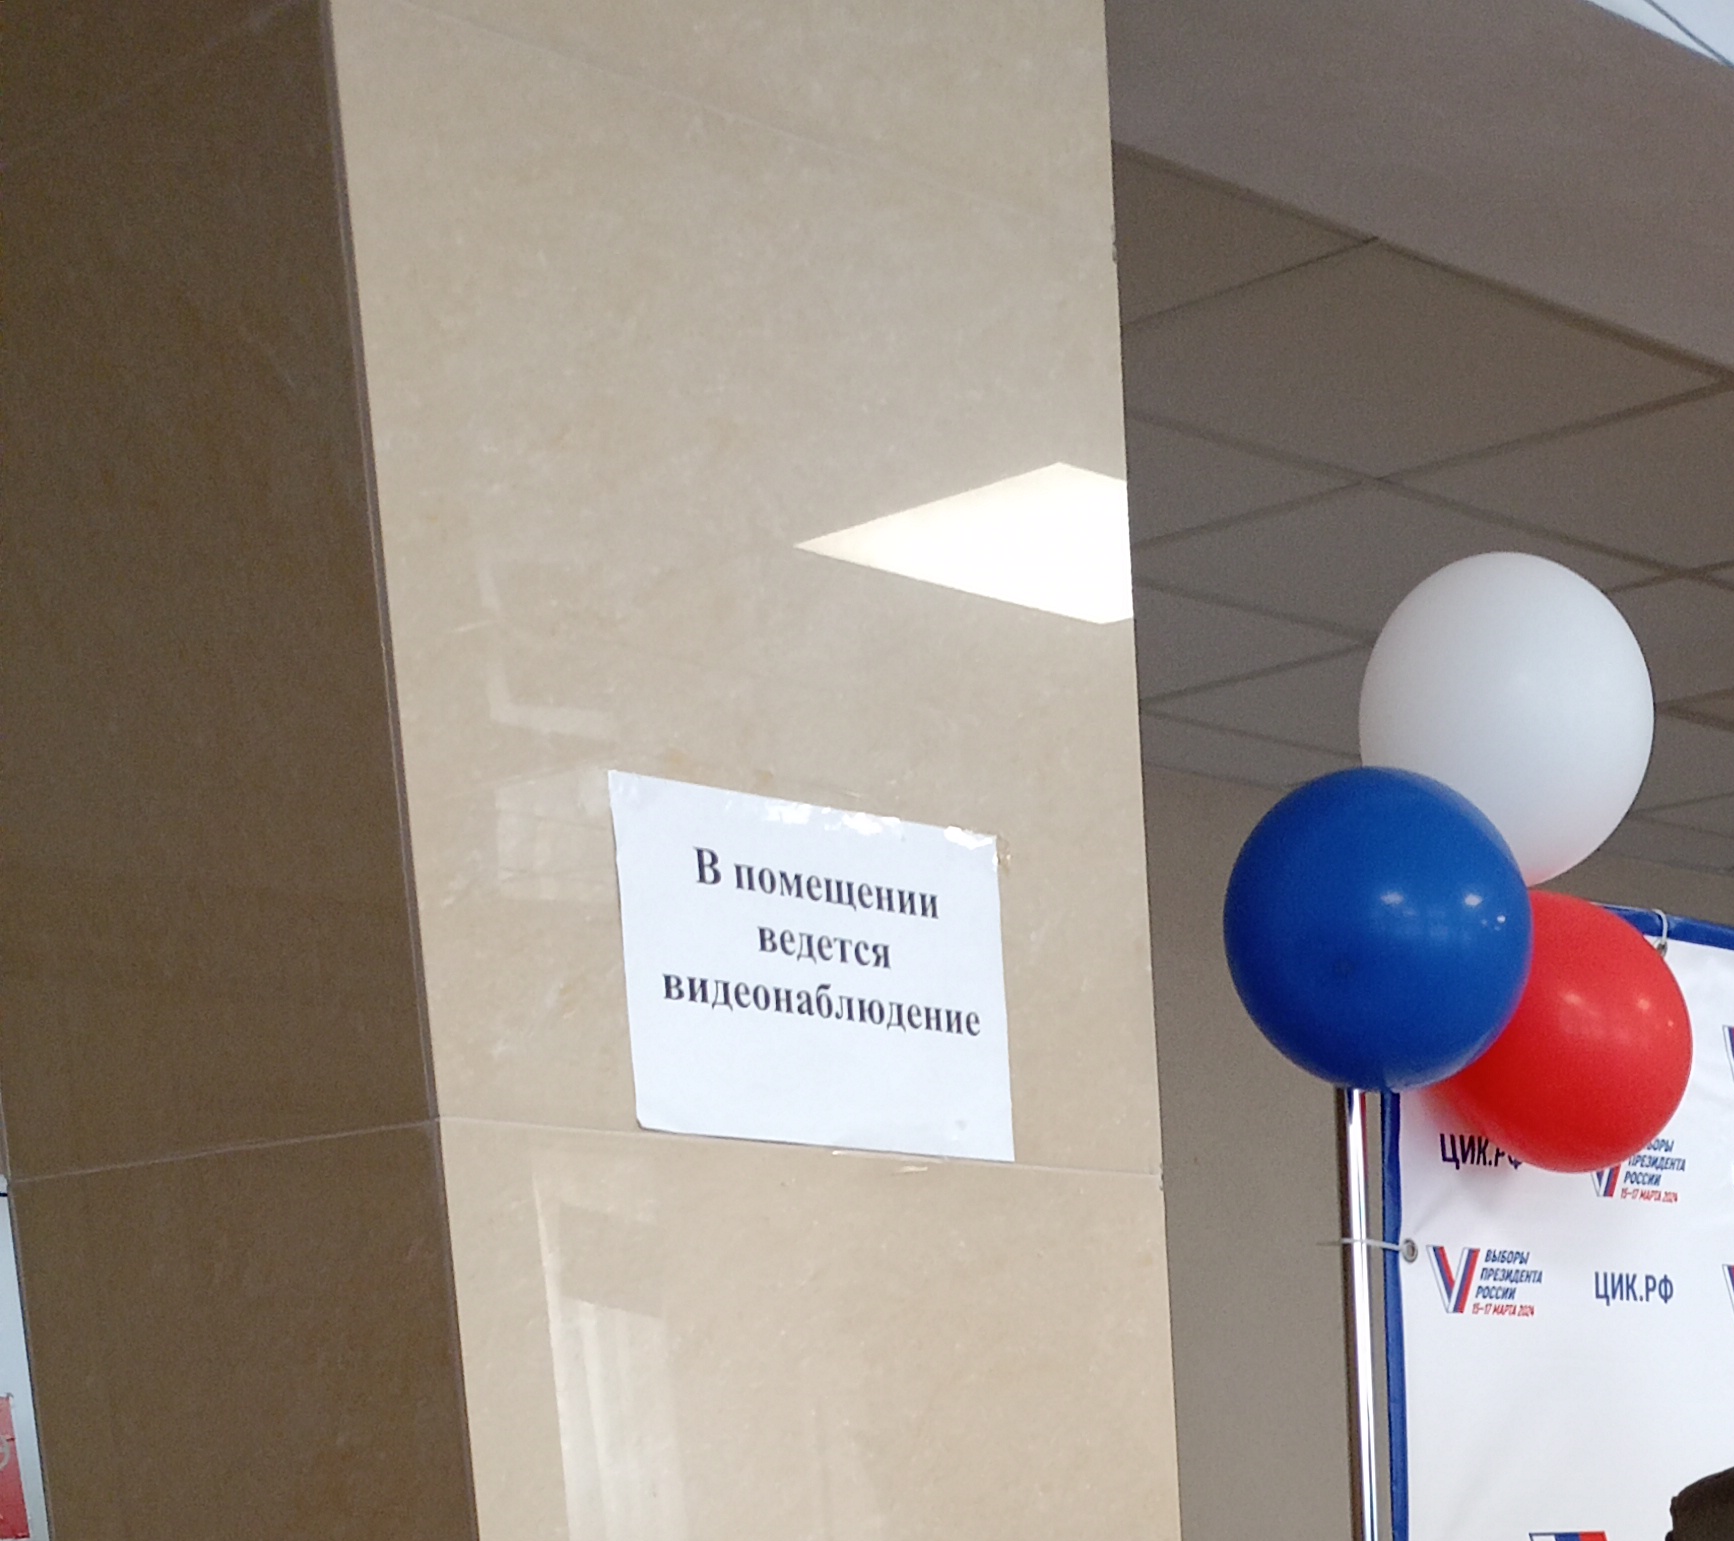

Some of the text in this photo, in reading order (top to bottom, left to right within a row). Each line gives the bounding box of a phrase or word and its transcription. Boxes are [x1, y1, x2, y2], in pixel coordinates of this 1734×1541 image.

[694, 846, 940, 920] В помещении
[758, 926, 892, 969] ведется
[662, 973, 982, 1037] видеонаблюдение
[1628, 1154, 1686, 1172] ПРЕЗИДЕНТА
[1623, 1171, 1662, 1187] РОССИИ
[1484, 1249, 1530, 1265] ВЫБОРЫ
[1480, 1267, 1543, 1284] ПРЕЗИДЕНТА
[1475, 1285, 1517, 1300] РОССИИ
[1594, 1271, 1674, 1306] ЦИК.РФ
